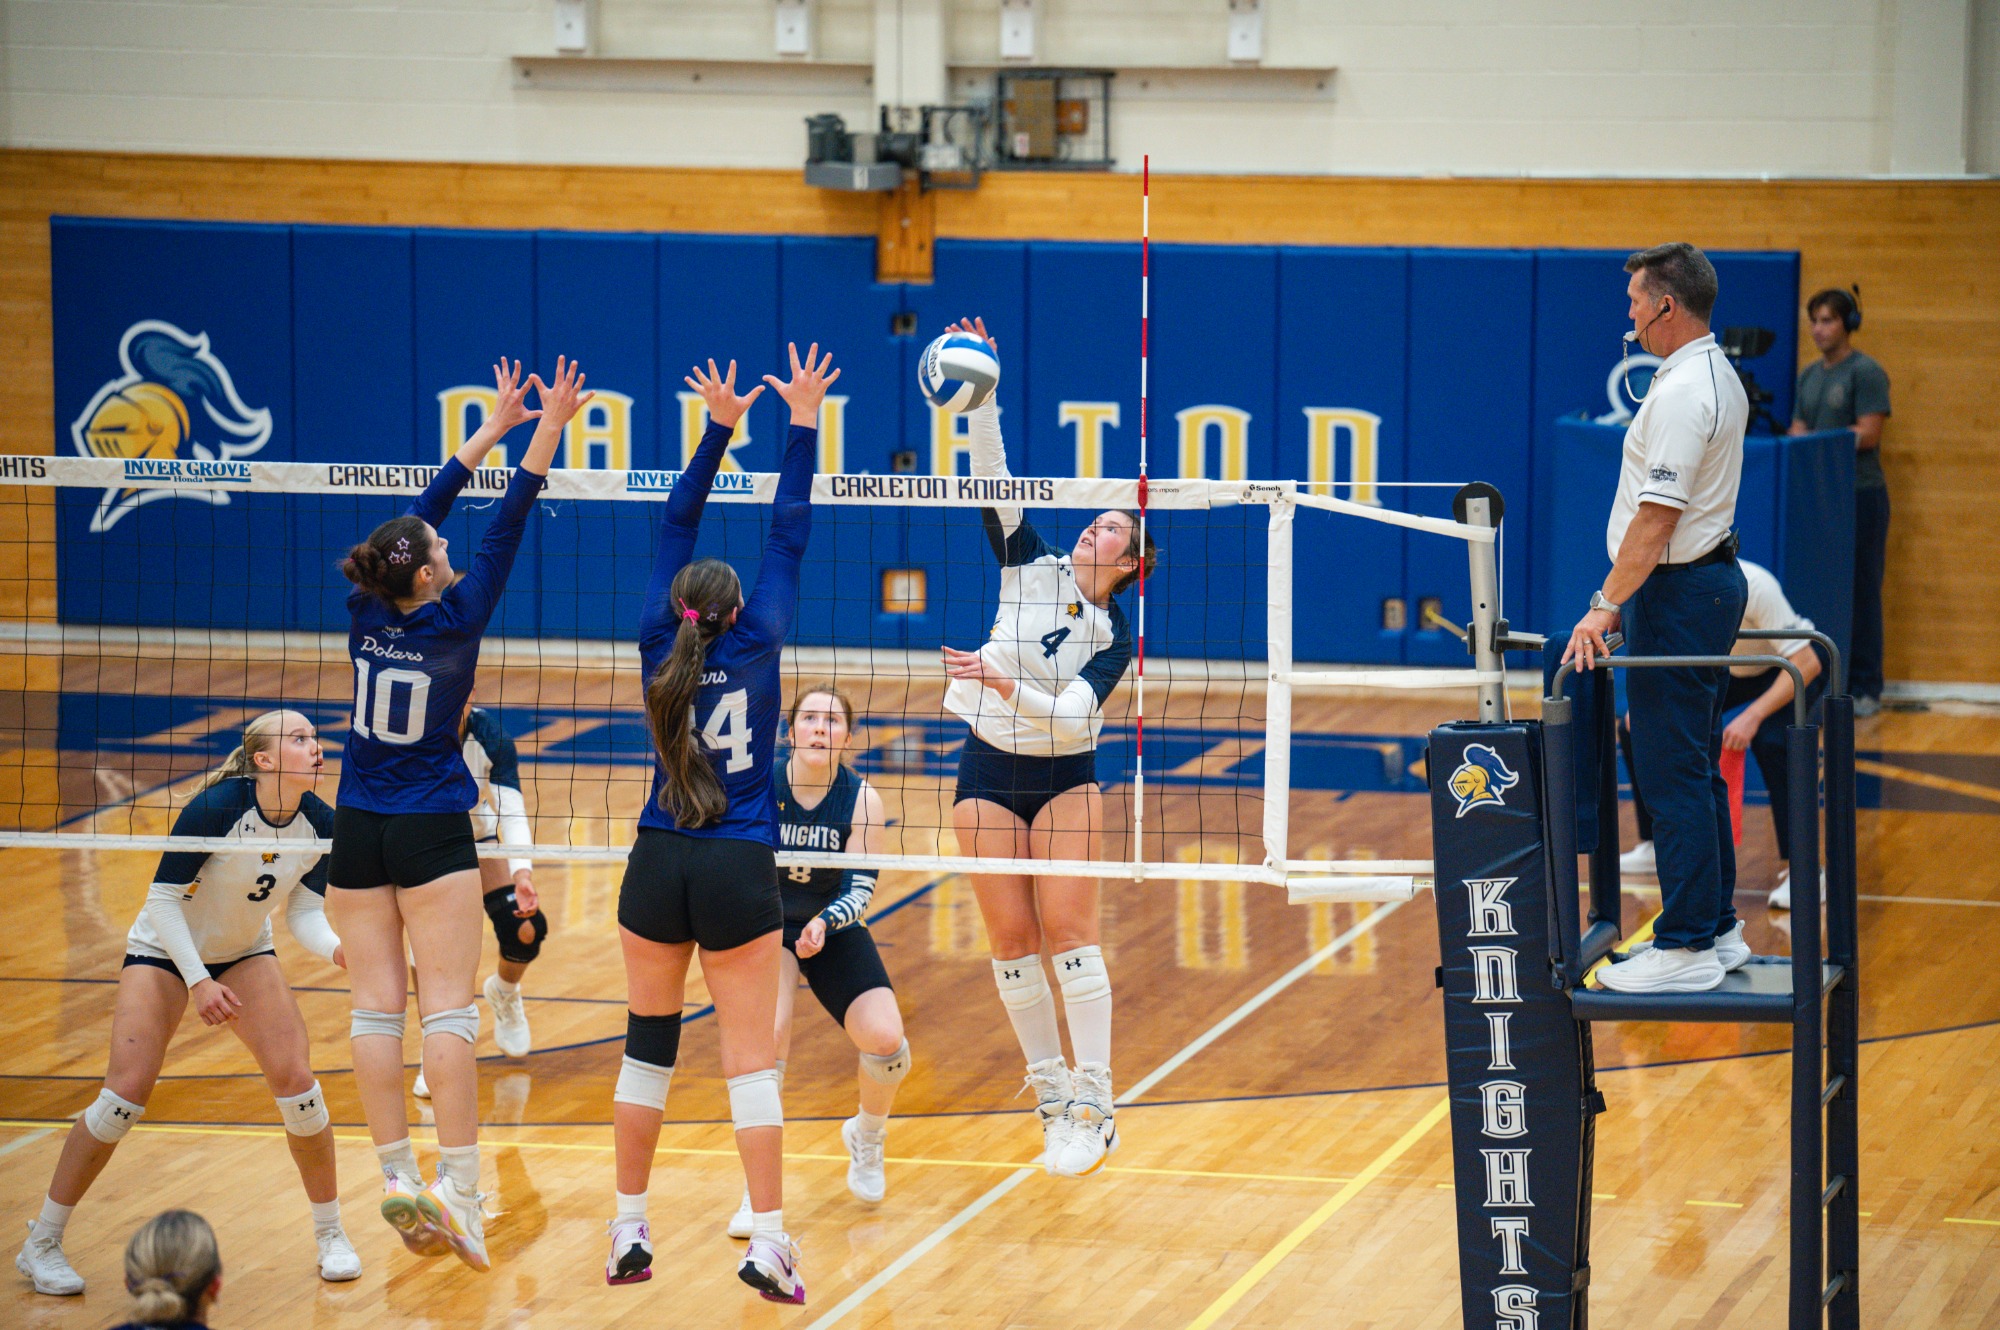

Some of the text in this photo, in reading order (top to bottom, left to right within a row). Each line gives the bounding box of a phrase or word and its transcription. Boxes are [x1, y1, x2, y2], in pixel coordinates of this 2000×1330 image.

[0, 456, 46, 478] HTS
[124, 460, 252, 477] INVER GROVE
[711, 473, 754, 489] OVE
[831, 476, 1054, 501] CARLETON KNIGHTS
[360, 635, 424, 662] Polars
[1040, 626, 1072, 659] 4
[698, 670, 728, 686] ars
[352, 657, 432, 745] 10
[688, 687, 754, 774] 4
[778, 823, 841, 851] NIGHTS
[246, 873, 277, 902] 3
[1462, 876, 1540, 1330] KNIGHTS
